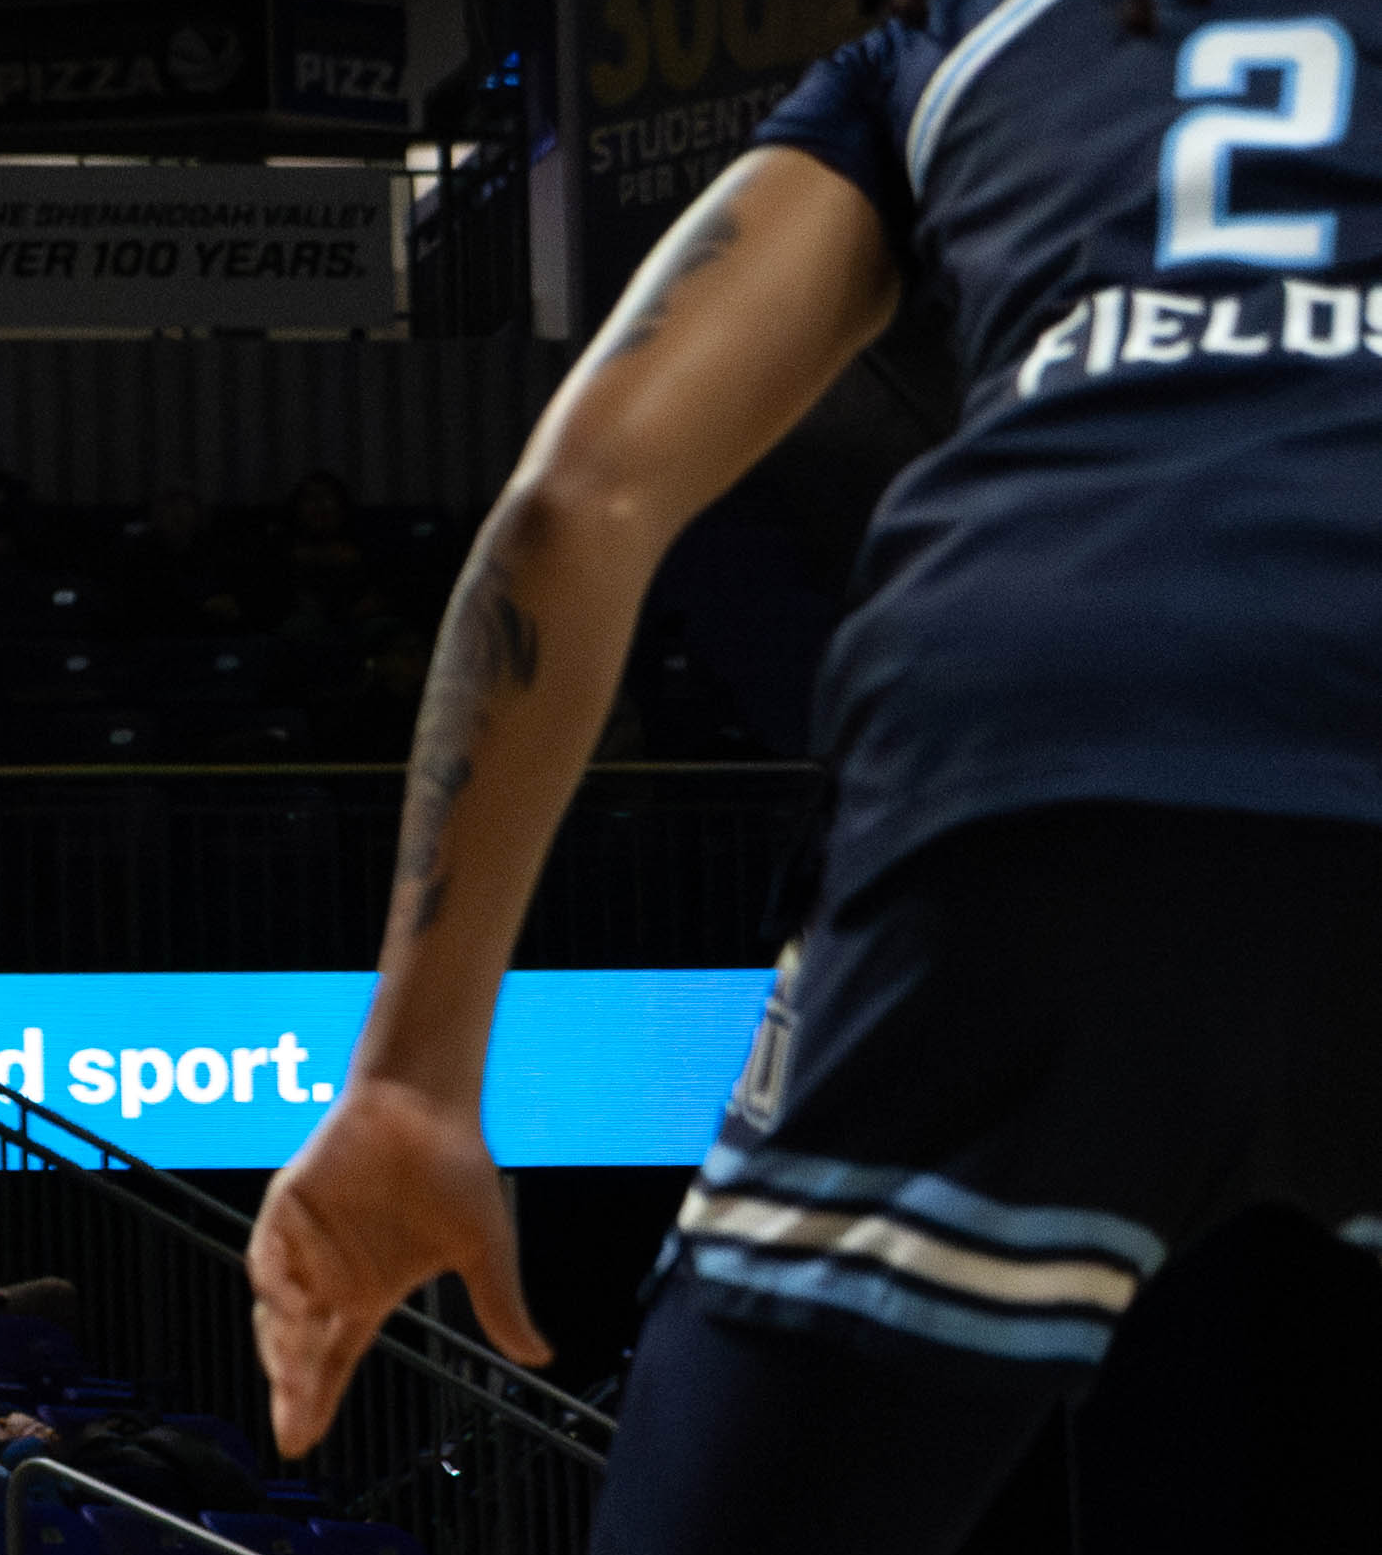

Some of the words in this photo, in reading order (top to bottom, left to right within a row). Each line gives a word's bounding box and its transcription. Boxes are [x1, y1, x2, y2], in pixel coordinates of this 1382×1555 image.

[293, 52, 405, 102] PIZZ
[1154, 16, 1357, 270] 2
[35, 202, 255, 229] SHENANDOAH
[264, 204, 378, 229] VALLEY
[93, 238, 178, 279] 100
[194, 239, 366, 279] YEARS.
[67, 1031, 335, 1119] sport.
